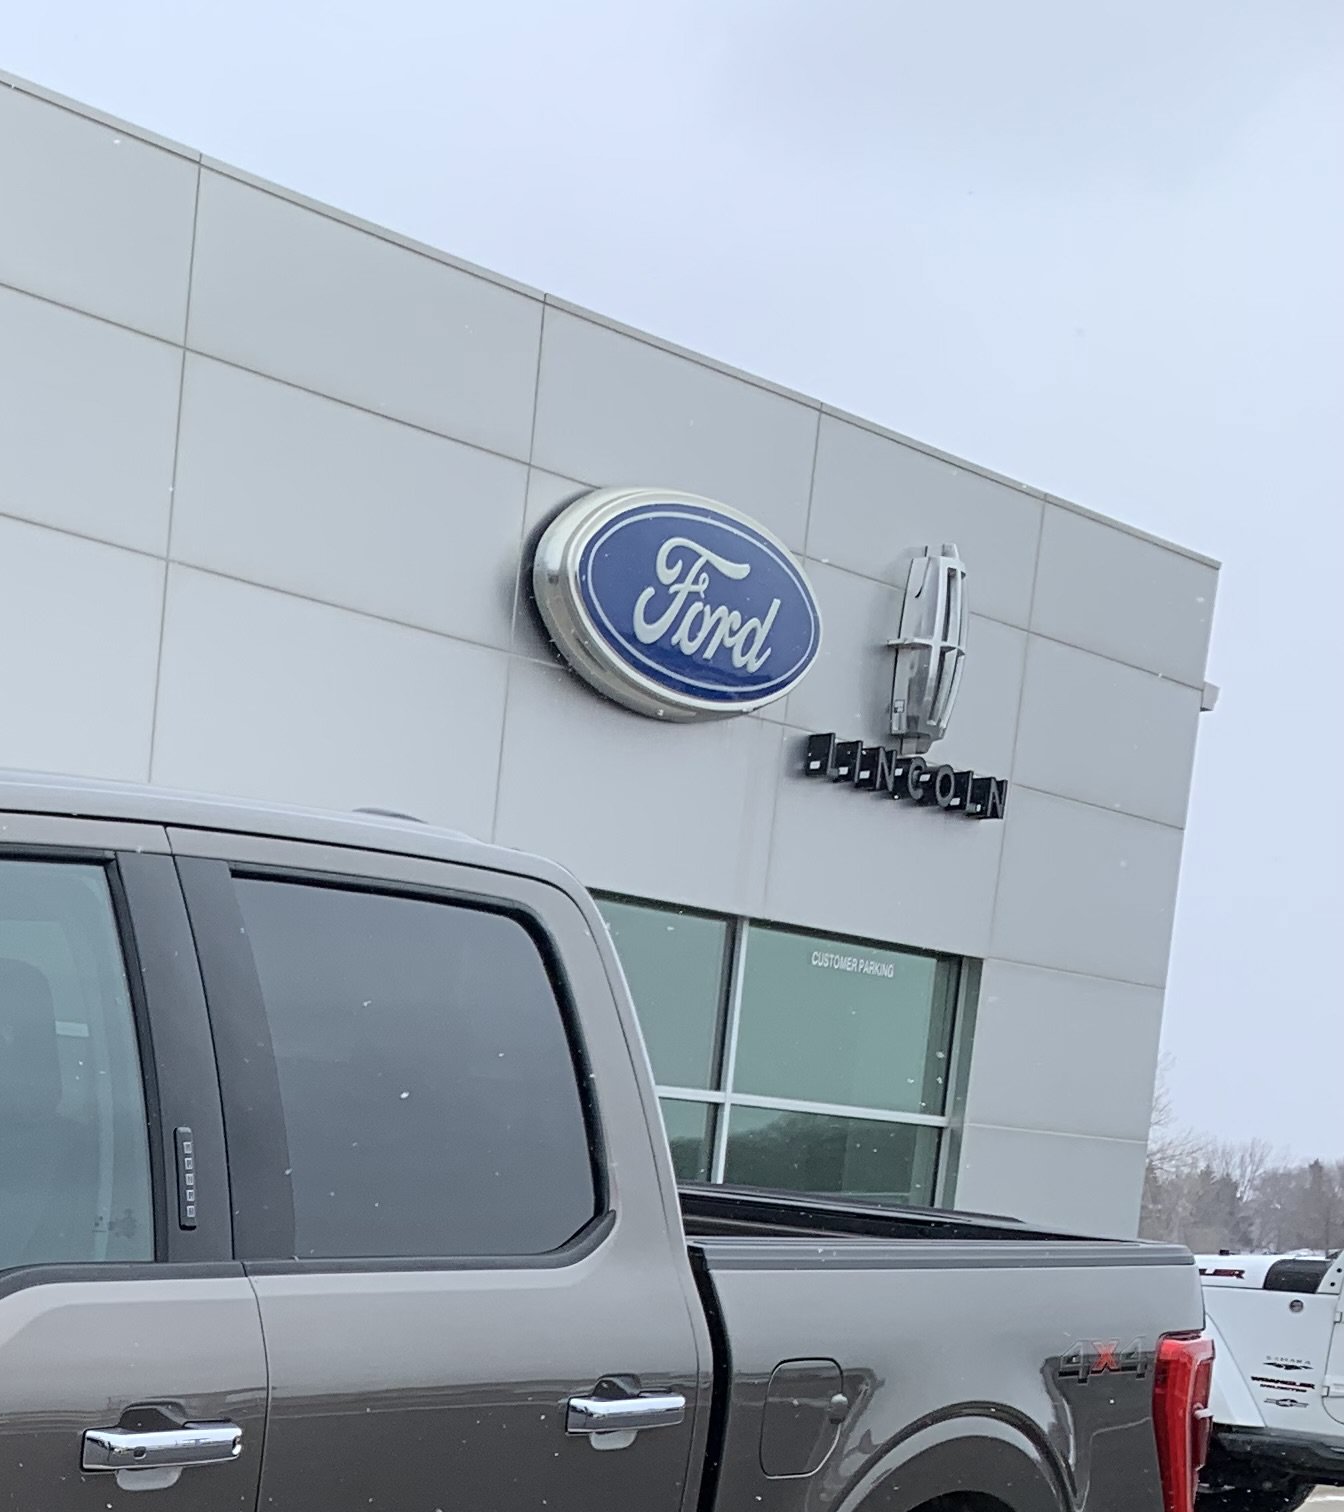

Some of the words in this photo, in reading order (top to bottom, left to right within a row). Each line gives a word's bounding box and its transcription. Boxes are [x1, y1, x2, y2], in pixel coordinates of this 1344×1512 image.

[633, 536, 782, 674] Ford
[805, 732, 1008, 820] LINCOLN
[811, 951, 857, 972] CUSTOMER
[858, 959, 894, 978] PARKING
